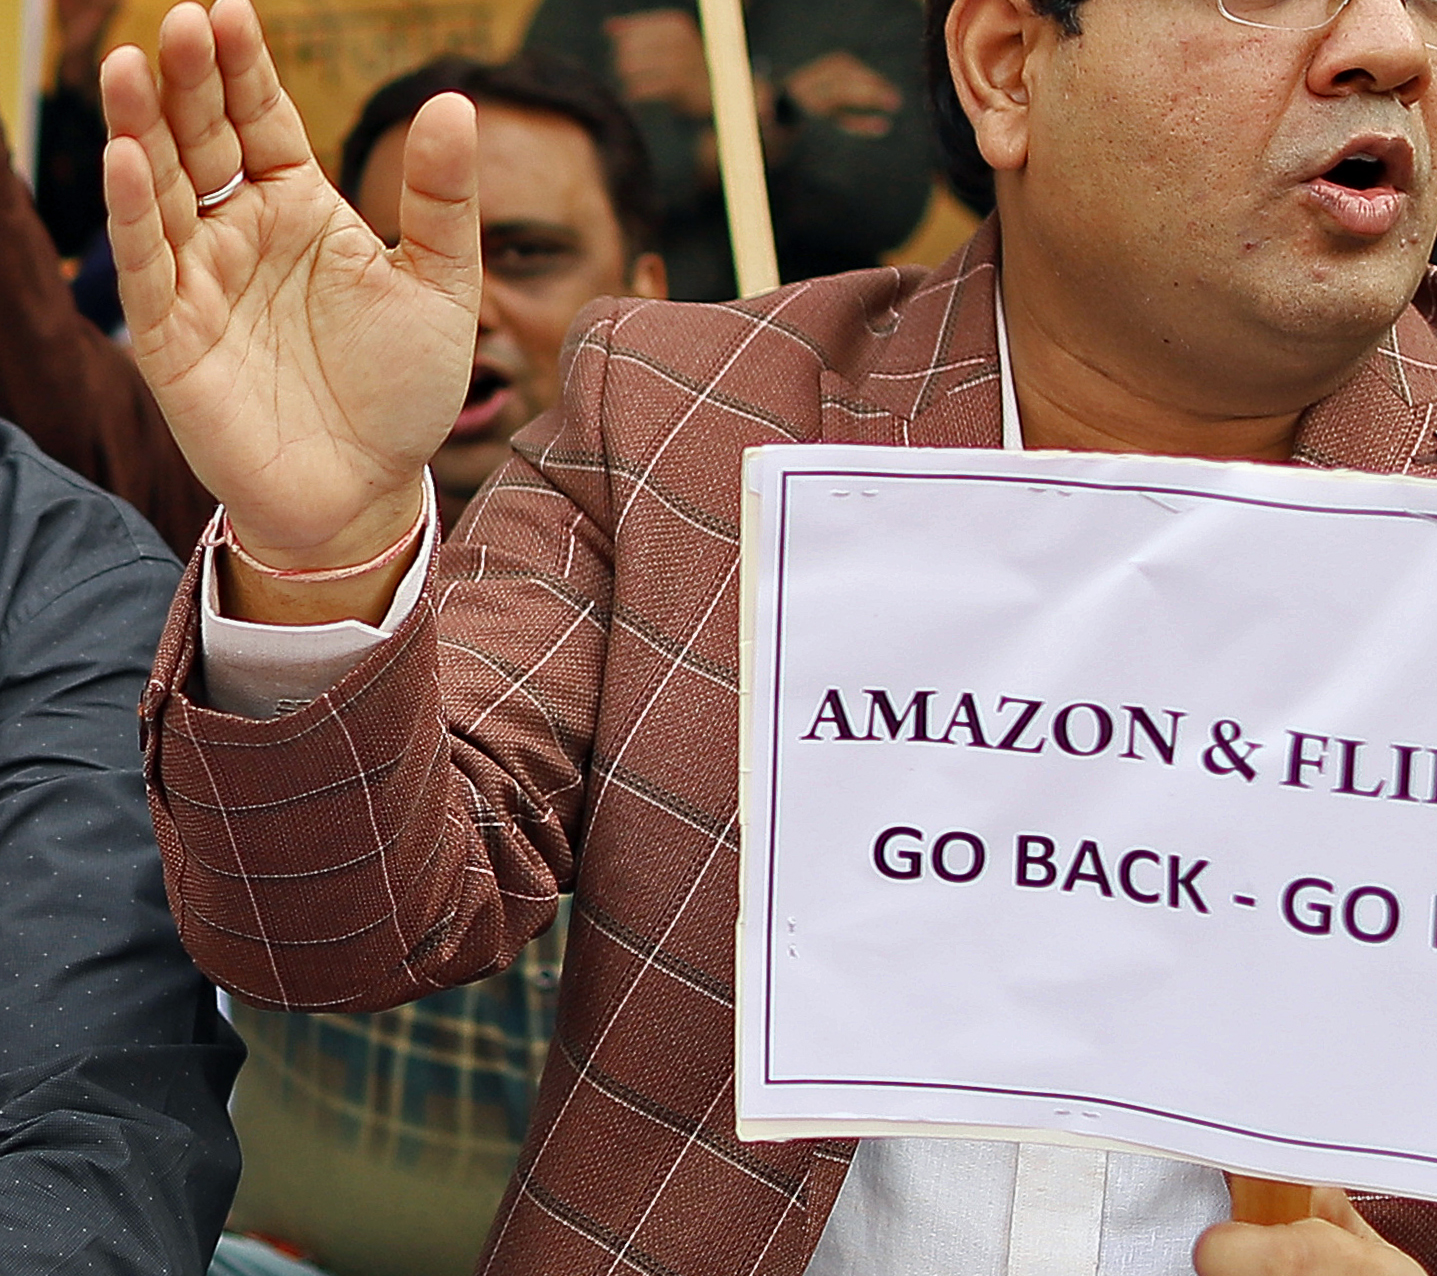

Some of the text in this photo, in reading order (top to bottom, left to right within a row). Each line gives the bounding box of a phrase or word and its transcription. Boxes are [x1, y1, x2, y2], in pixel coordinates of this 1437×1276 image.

[799, 687, 1186, 764] AMAZON
[1201, 718, 1264, 783] &
[872, 826, 986, 885] GO
[1014, 834, 1212, 914] BACK
[1233, 891, 1257, 909] -
[1279, 876, 1401, 945] GO
